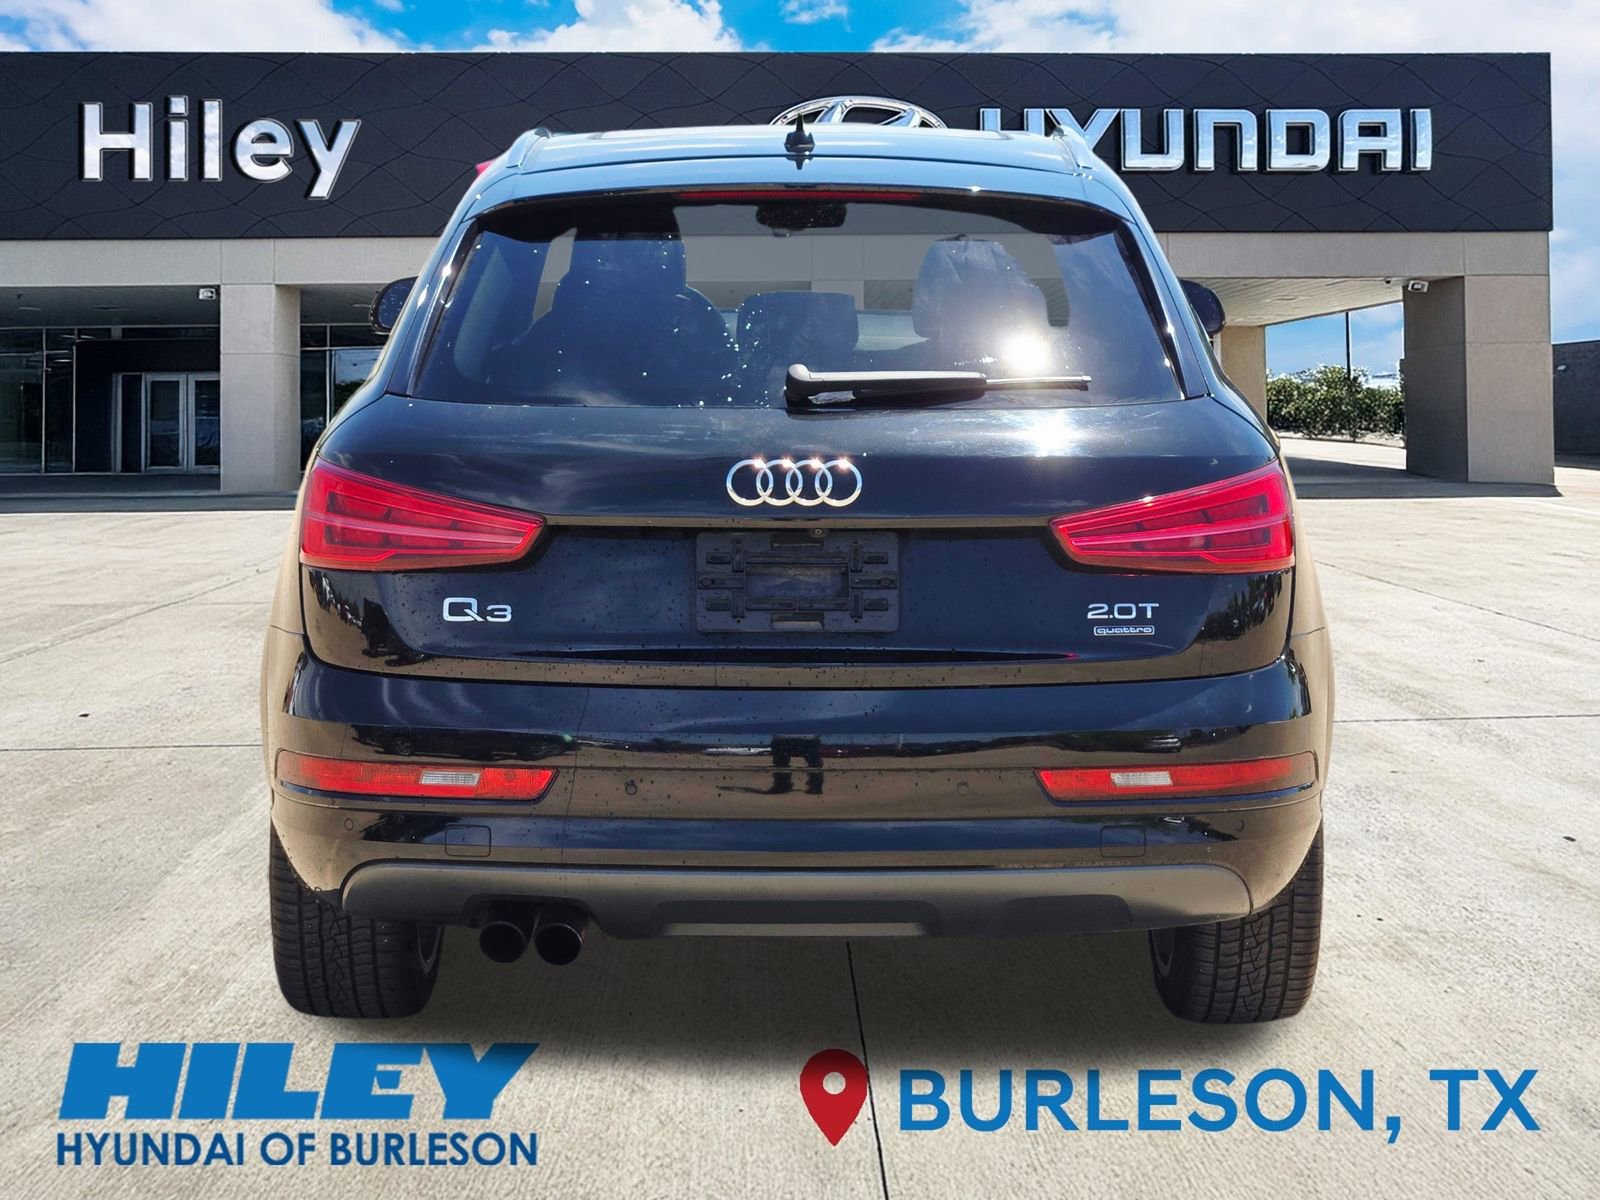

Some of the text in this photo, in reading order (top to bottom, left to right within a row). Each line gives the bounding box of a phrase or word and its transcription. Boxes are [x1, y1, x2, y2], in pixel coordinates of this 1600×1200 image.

[80, 95, 362, 199] Hiley
[442, 597, 512, 622] Q3
[1087, 603, 1159, 619] 2.0T
[1096, 626, 1153, 635] quattro
